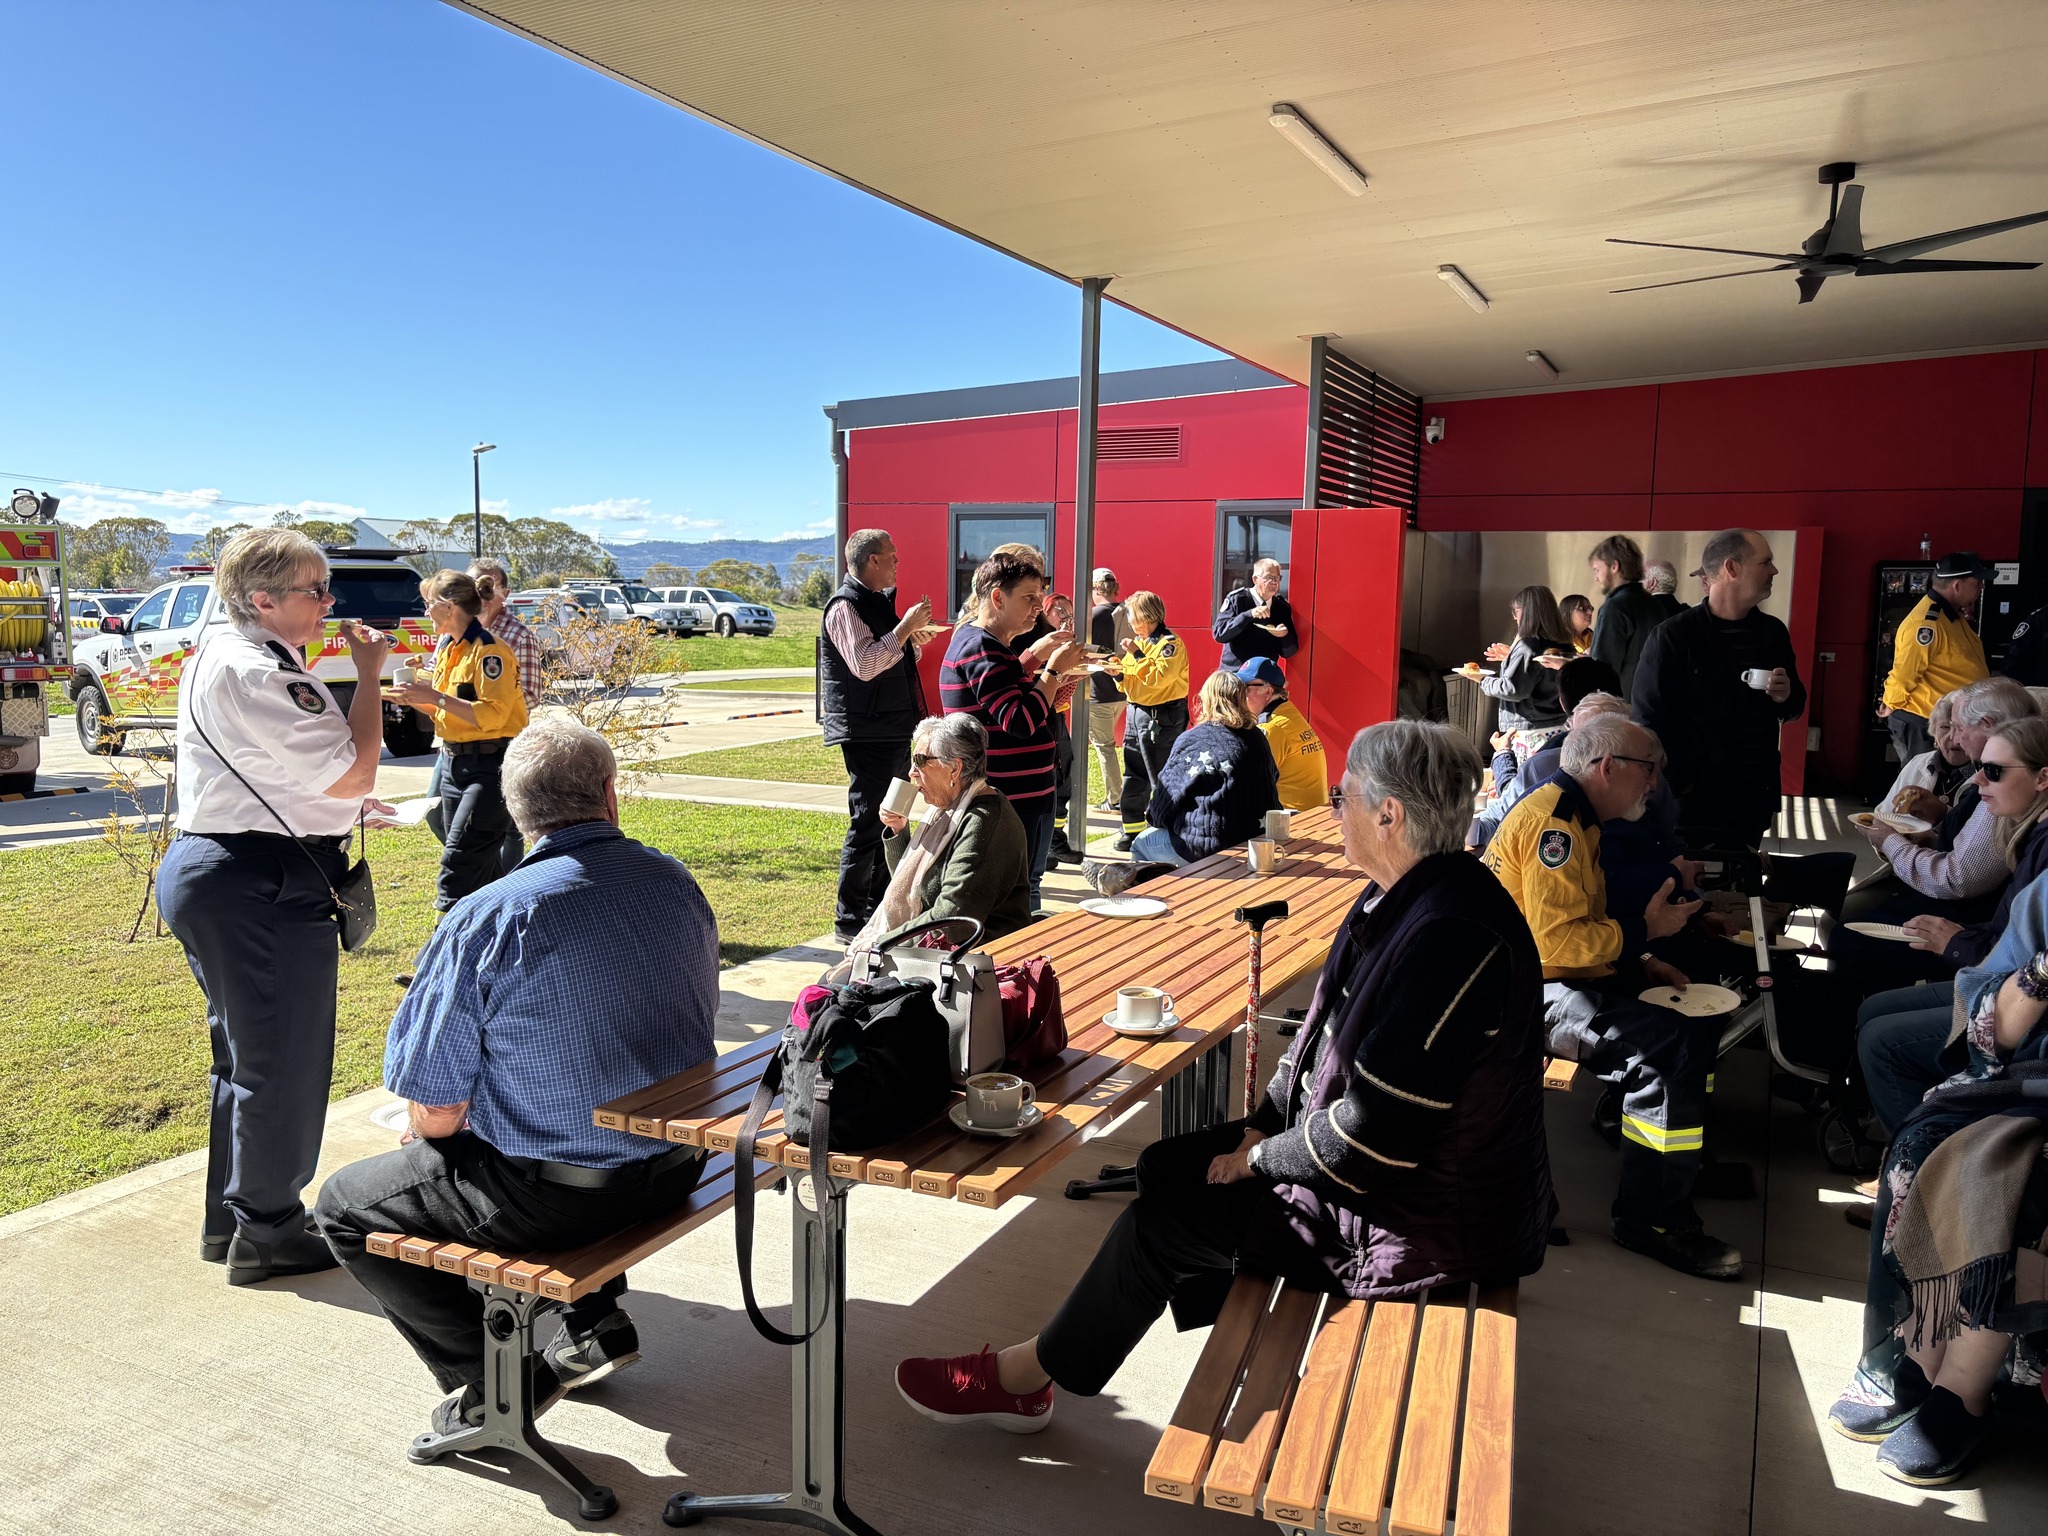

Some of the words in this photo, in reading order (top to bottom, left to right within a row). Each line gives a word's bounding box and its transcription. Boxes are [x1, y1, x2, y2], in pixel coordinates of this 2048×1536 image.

[324, 637, 349, 649] FIR
[409, 634, 438, 646] FIRE
[1301, 741, 1318, 755] FIRE
